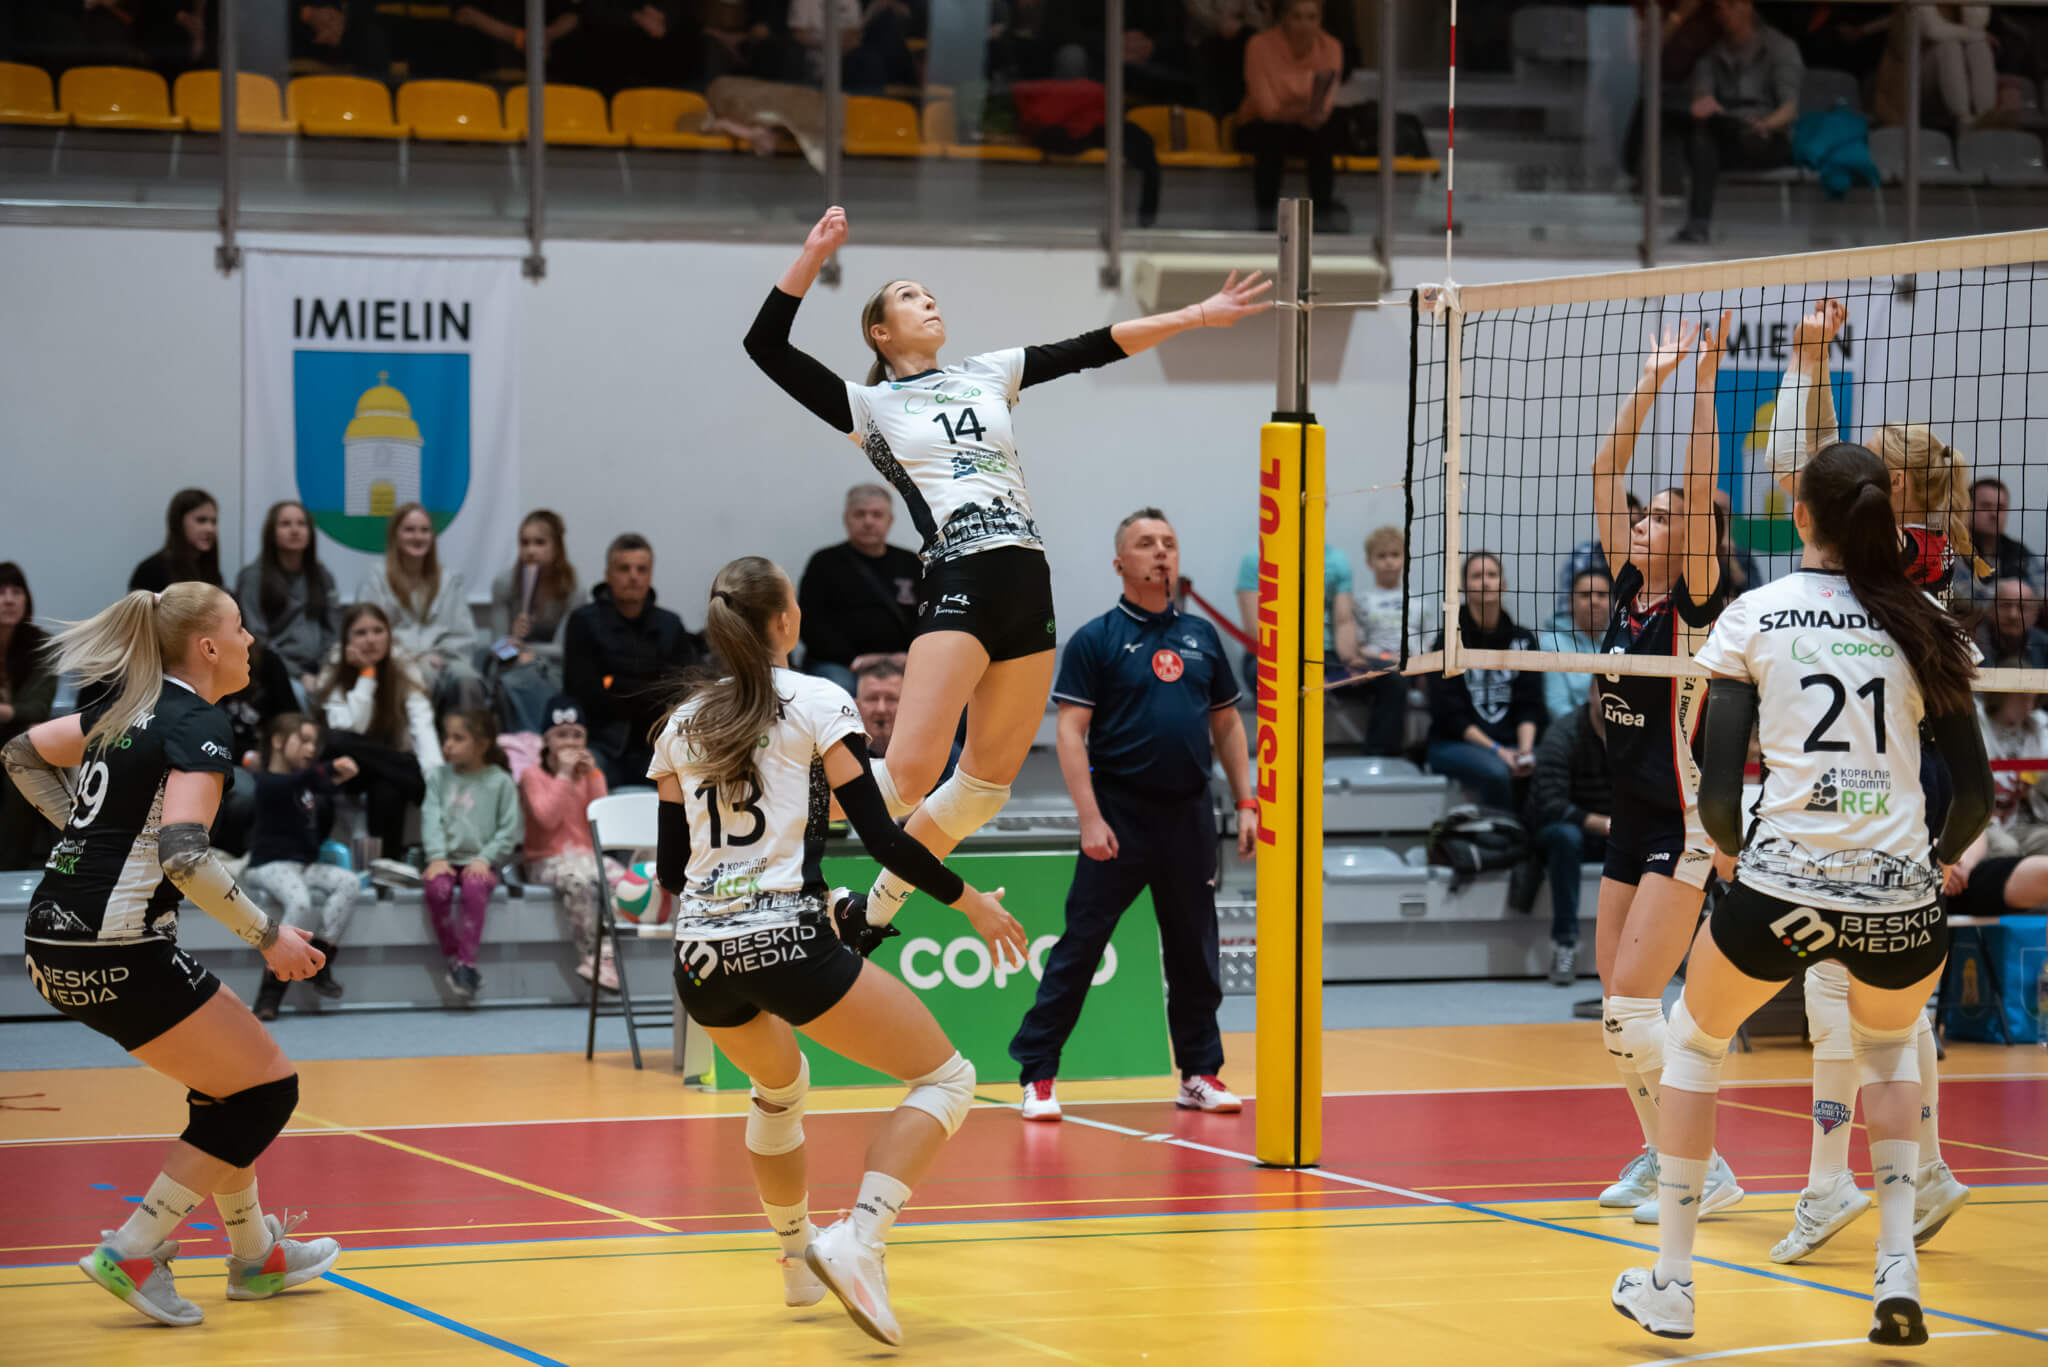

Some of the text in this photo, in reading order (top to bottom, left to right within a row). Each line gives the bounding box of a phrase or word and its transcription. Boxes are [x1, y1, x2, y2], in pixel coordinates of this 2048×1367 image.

[293, 297, 471, 342] IMIELIN
[932, 407, 987, 445] 14
[1832, 642, 1895, 658] COPCO
[1604, 703, 1645, 727] Enea
[1800, 673, 1887, 754] 21
[1841, 768, 1891, 780] KOPALNIA
[1841, 777, 1892, 790] DOLOMITU
[68, 761, 110, 830] 19
[694, 771, 767, 849] 13
[1841, 791, 1890, 815] REK
[1841, 905, 1942, 935] BESKID
[721, 925, 817, 957] BESKID
[1838, 930, 1932, 953] MEDIA
[723, 944, 808, 976] MEDIA
[43, 964, 130, 988] BESKID
